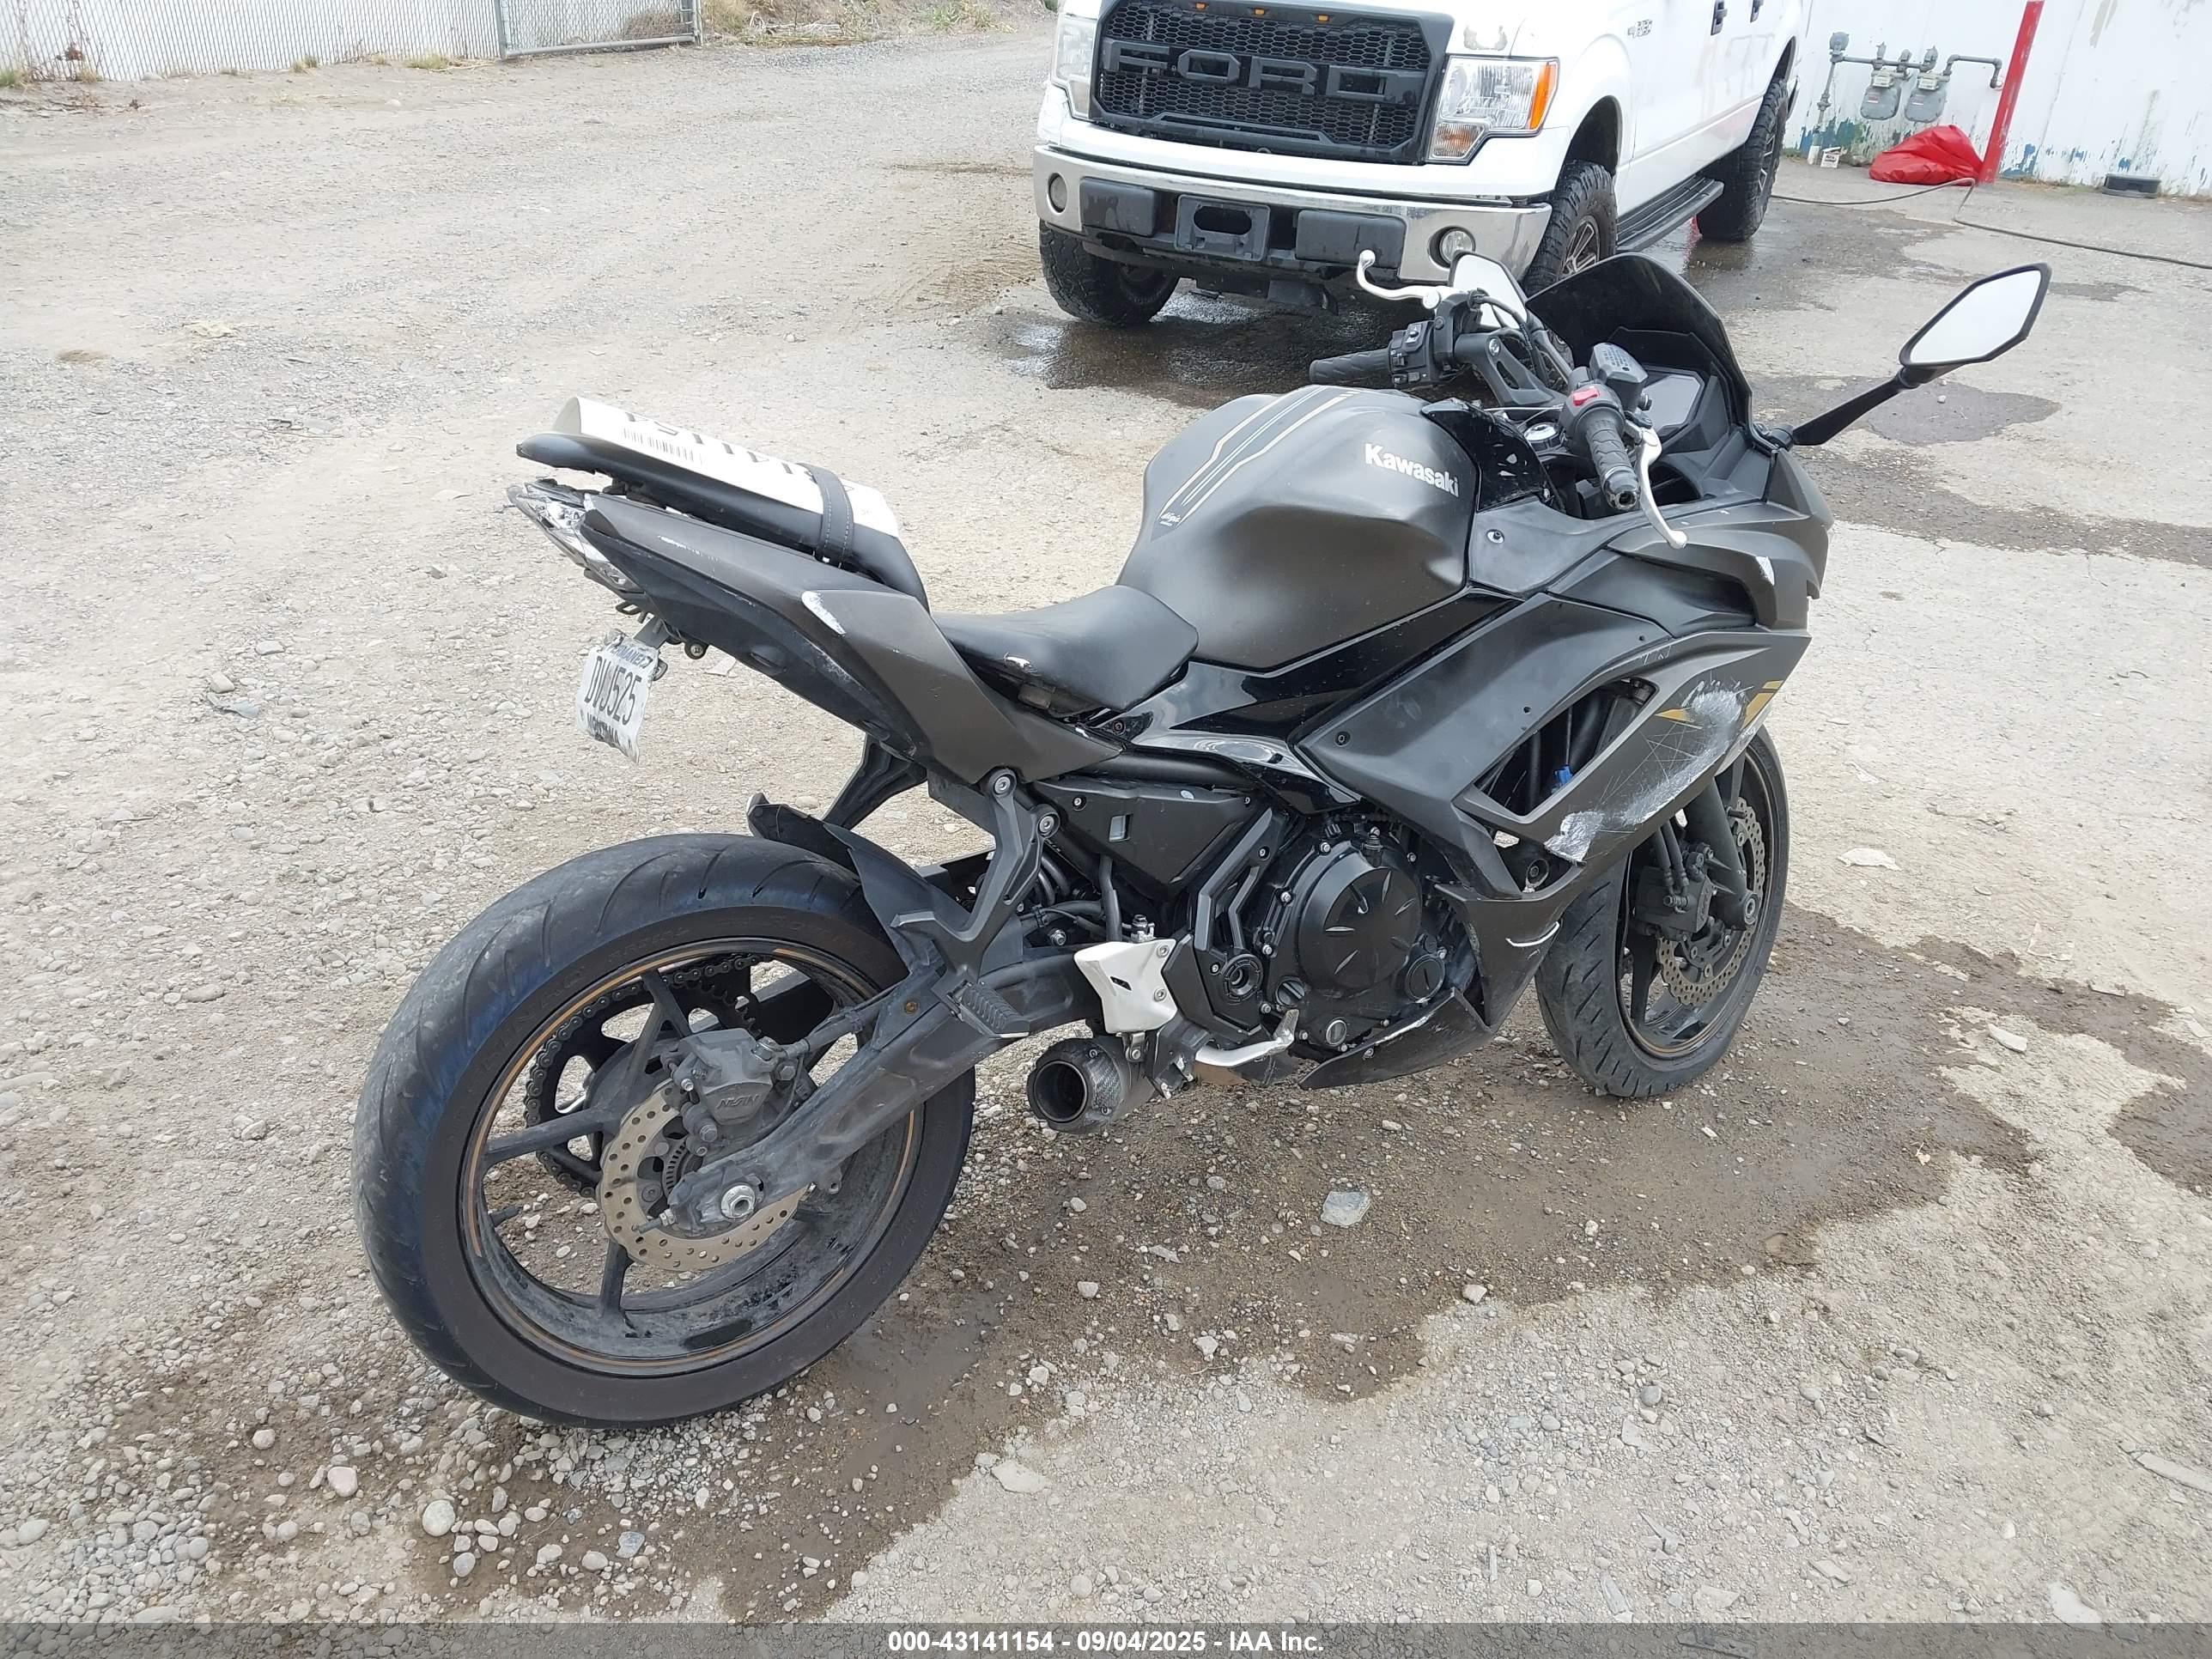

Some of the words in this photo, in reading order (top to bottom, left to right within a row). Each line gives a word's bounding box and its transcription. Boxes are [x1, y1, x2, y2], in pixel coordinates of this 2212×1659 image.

[1102, 40, 1417, 105] FORD
[1364, 442, 1459, 498] Kawasaki
[584, 655, 642, 726] DVJ525
[715, 1093, 760, 1109] NISSIN
